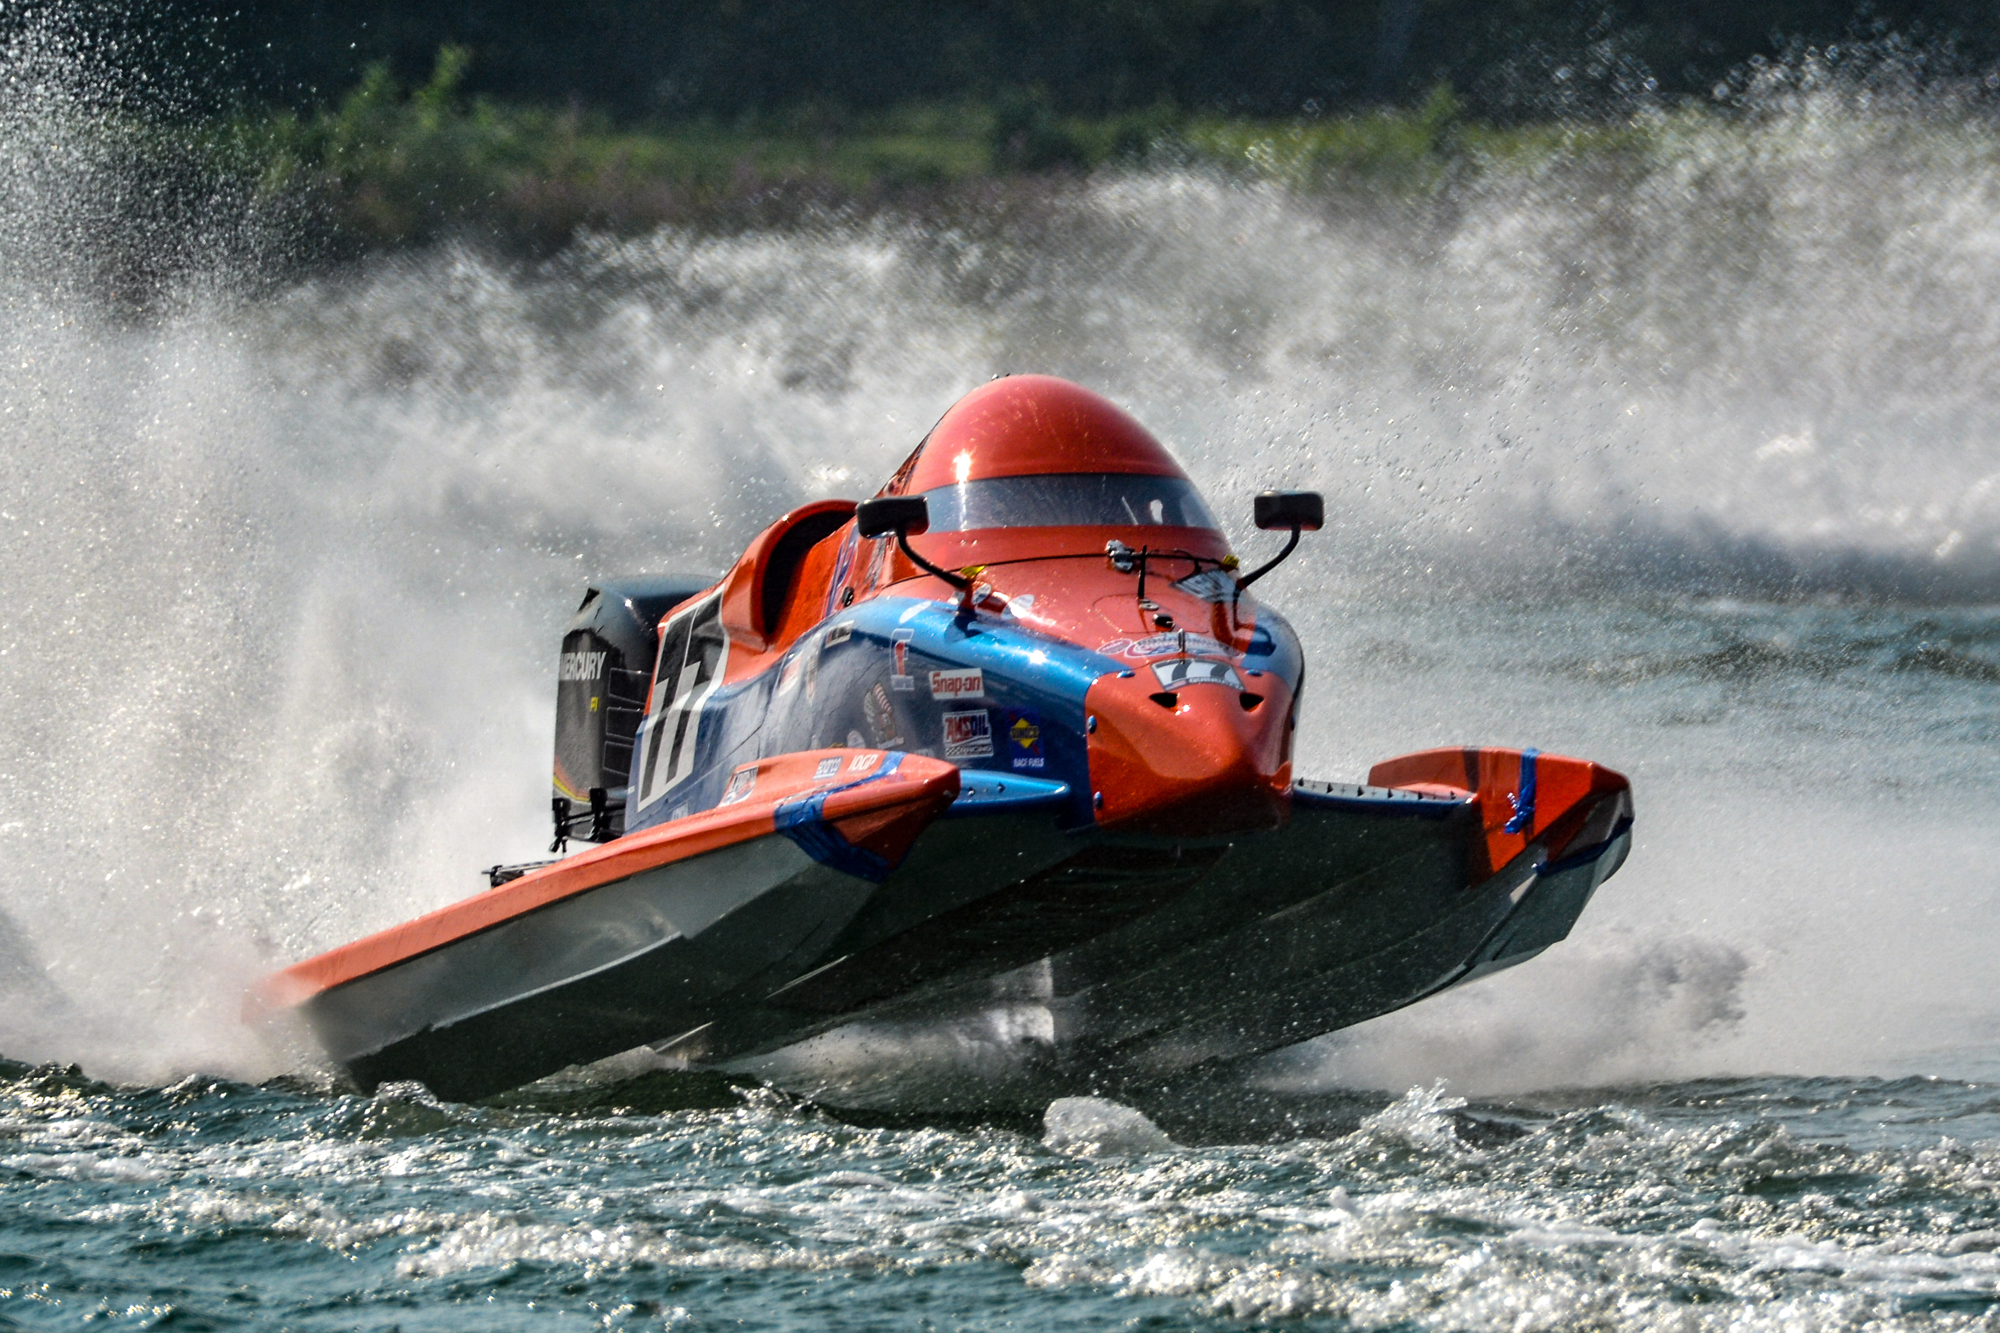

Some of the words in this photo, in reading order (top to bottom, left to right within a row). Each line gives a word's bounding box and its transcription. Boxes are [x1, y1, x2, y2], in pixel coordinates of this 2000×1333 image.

[559, 651, 607, 681] MERCURY
[932, 672, 982, 698] Snap-on
[945, 714, 990, 744] AMSOIL
